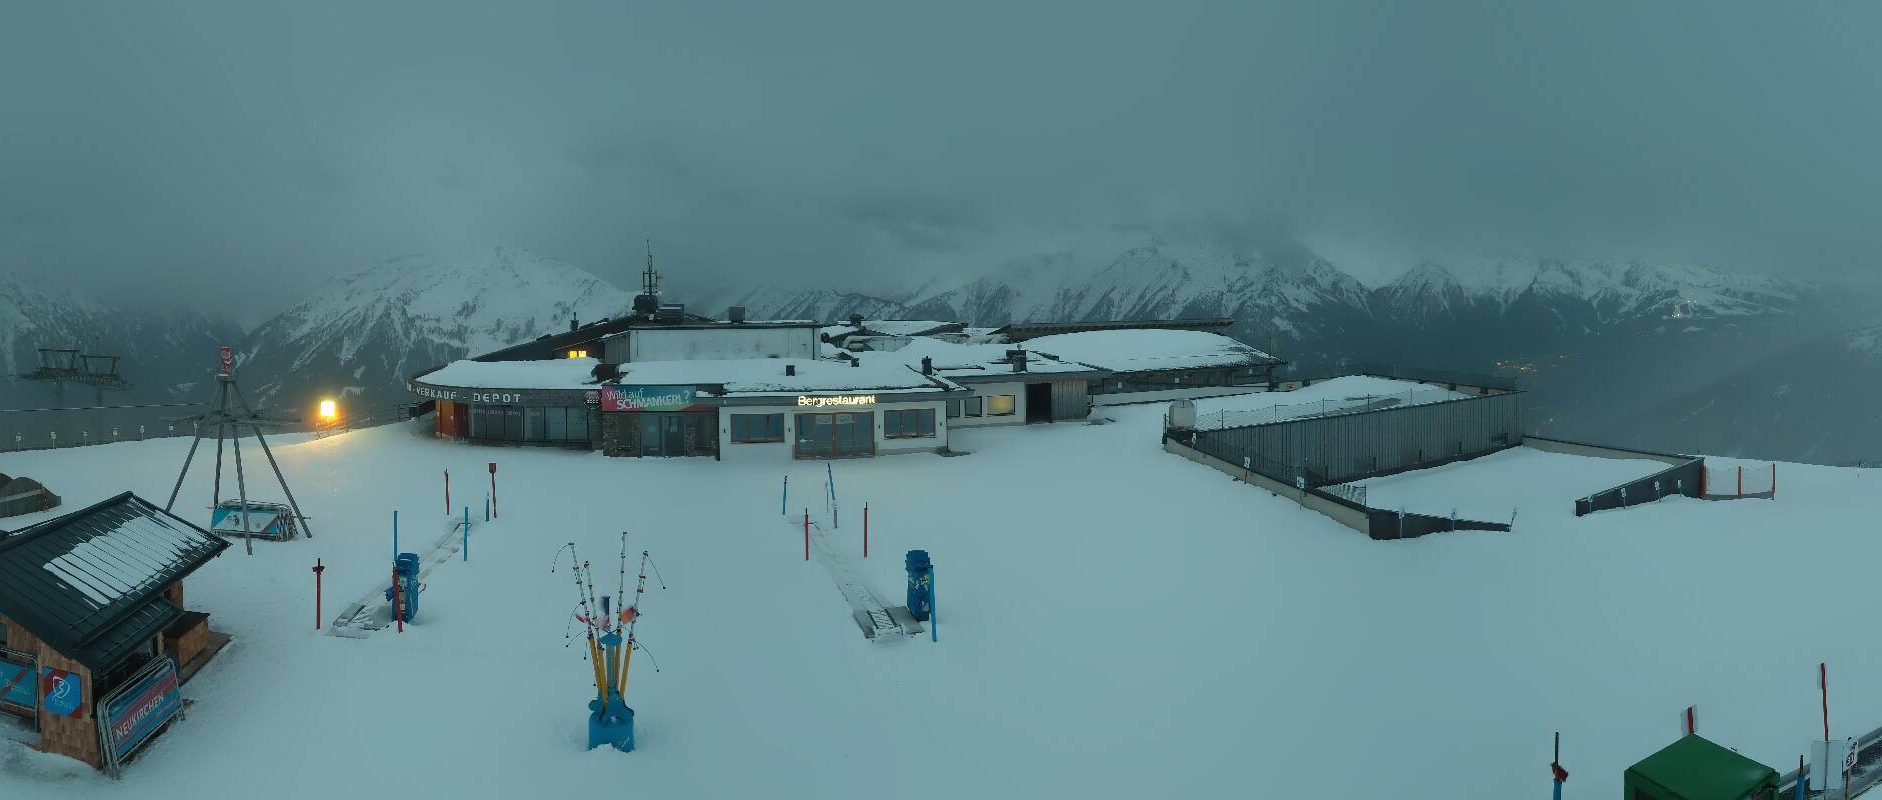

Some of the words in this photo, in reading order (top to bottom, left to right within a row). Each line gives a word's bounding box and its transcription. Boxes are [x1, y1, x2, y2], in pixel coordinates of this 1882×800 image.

[416, 386, 457, 400] VERKAUF
[473, 393, 521, 403] DEPOT
[606, 389, 627, 400] Wild
[628, 387, 644, 398] auf
[797, 395, 876, 407] Bergrestaurant
[115, 691, 165, 740] NEUKIRCHEN
